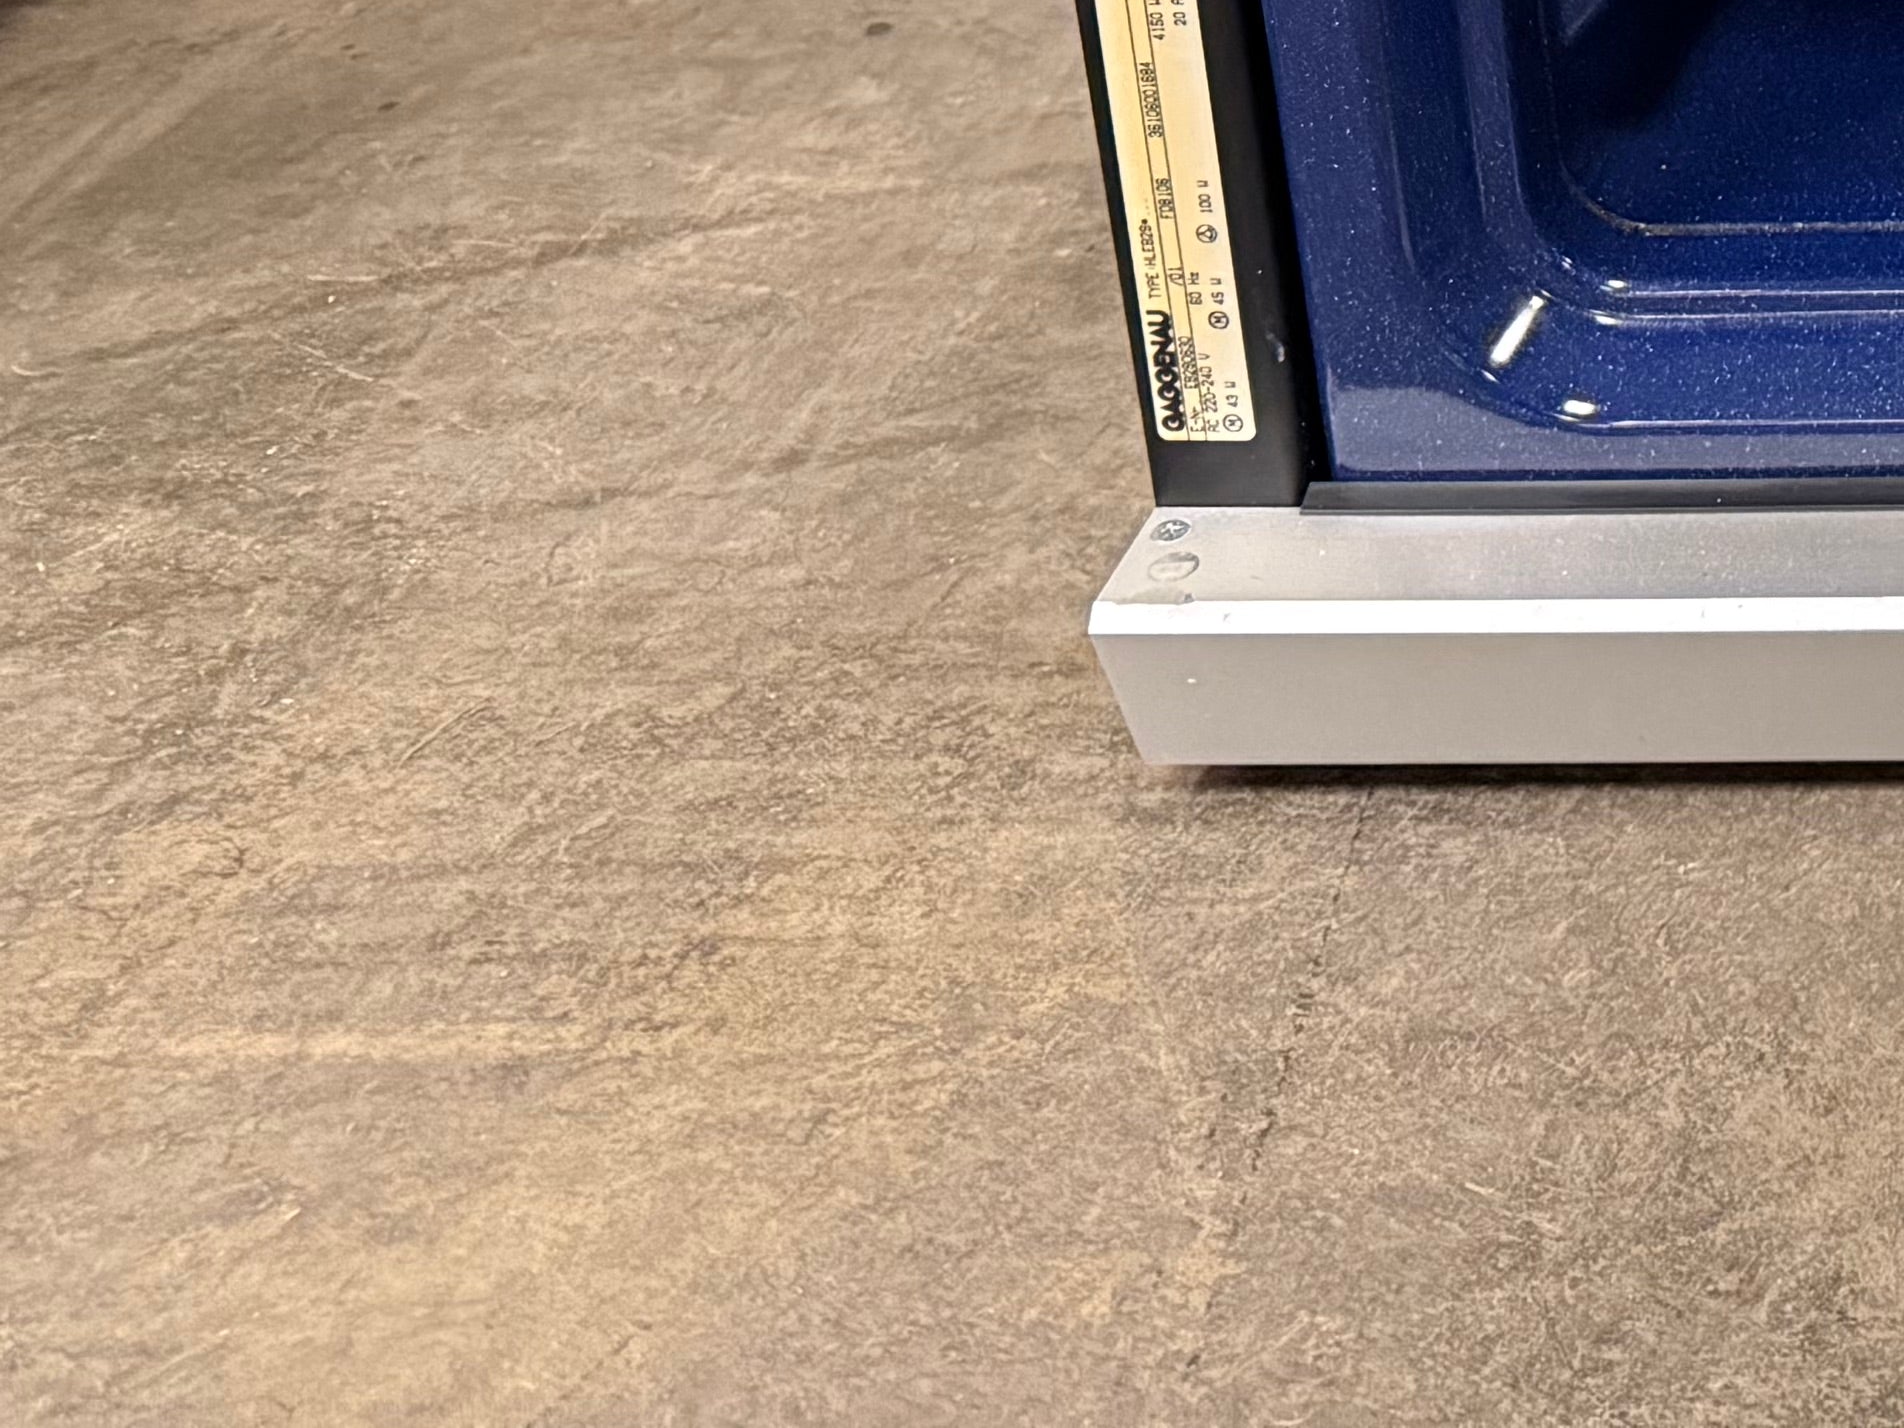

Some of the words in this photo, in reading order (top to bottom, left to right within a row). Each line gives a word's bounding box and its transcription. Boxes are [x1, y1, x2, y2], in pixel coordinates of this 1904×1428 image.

[1149, 12, 1165, 40] 4150
[1173, 12, 1187, 26] 20
[1197, 180, 1208, 188] W
[1198, 194, 1212, 213] 100
[1145, 273, 1161, 299] TYPE
[1188, 272, 1199, 285] Hz
[1188, 292, 1202, 305] 60
[1146, 310, 1185, 431] GAGGENAU
[1199, 366, 1218, 413] 220-240
[1225, 395, 1238, 407] 43
